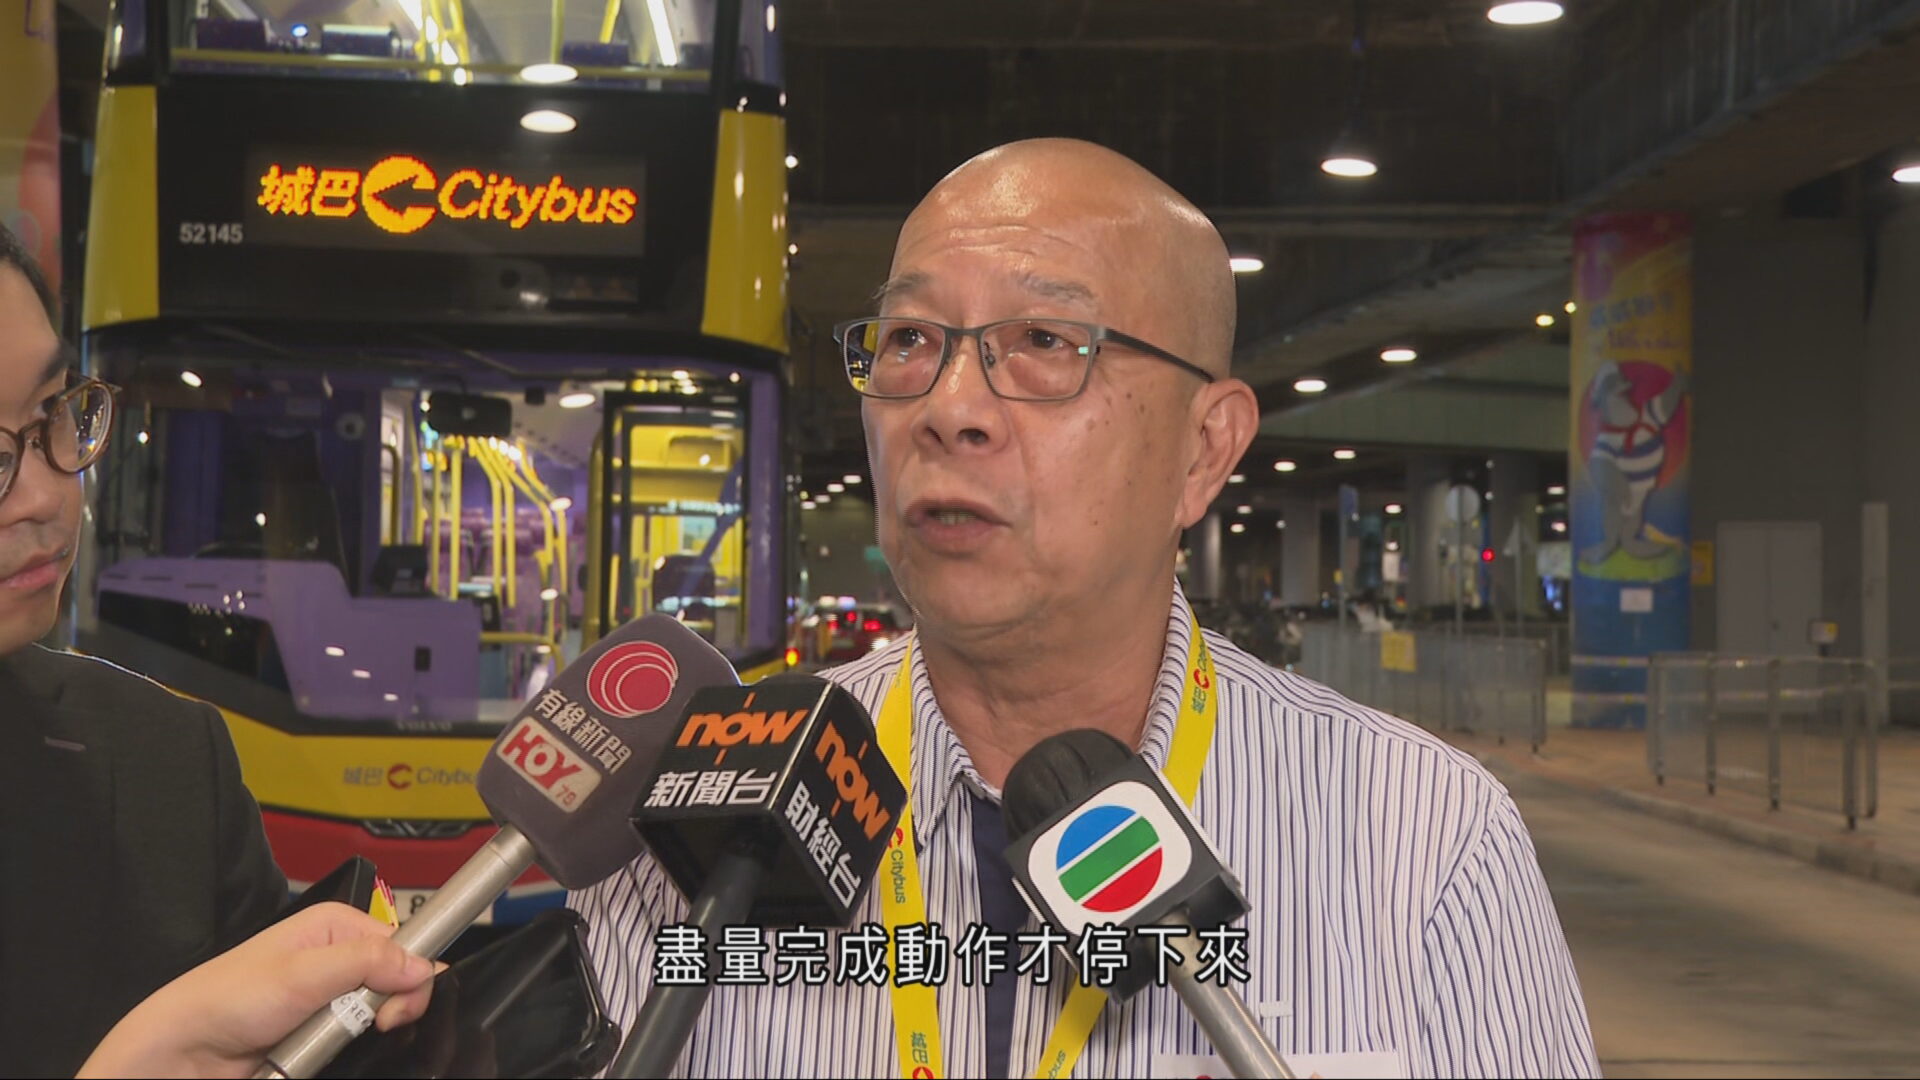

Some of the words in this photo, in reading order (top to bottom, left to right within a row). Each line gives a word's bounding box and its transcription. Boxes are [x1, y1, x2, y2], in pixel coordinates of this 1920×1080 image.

[257, 164, 361, 217] 城巴
[438, 169, 637, 229] Citybus
[180, 222, 244, 244] 52145
[534, 688, 634, 774] 有線新聞
[676, 708, 809, 748] now
[417, 766, 476, 787] Citybu
[501, 725, 586, 790] HOY
[814, 721, 891, 840] now
[644, 769, 778, 808] 新聞台
[785, 781, 862, 908] 財經台
[890, 848, 906, 905] Citybus
